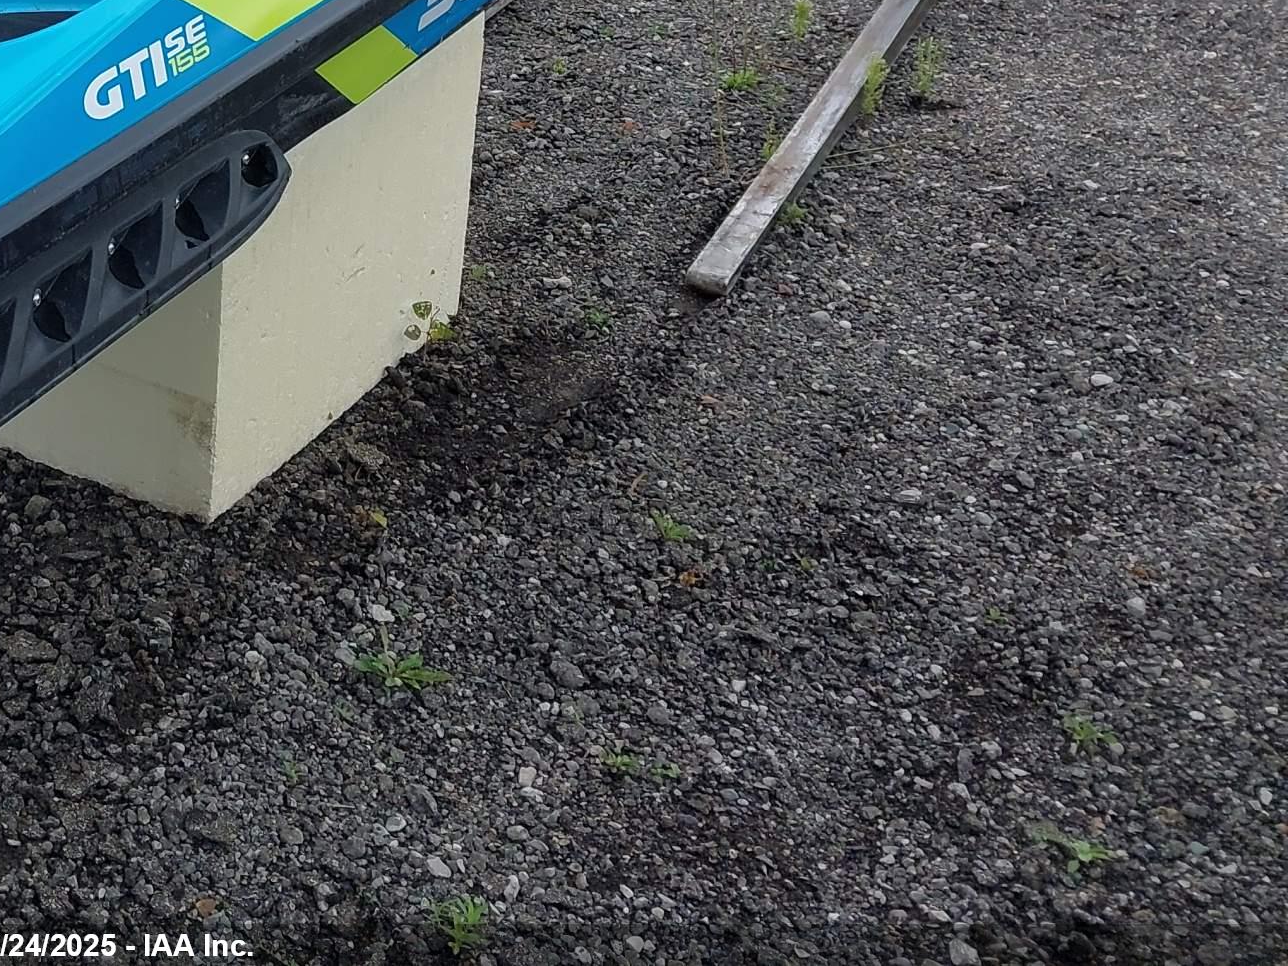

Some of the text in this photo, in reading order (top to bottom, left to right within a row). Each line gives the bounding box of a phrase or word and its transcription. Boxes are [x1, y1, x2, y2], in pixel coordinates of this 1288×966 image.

[83, 14, 208, 121] GTI SE
[168, 39, 211, 77] 155
